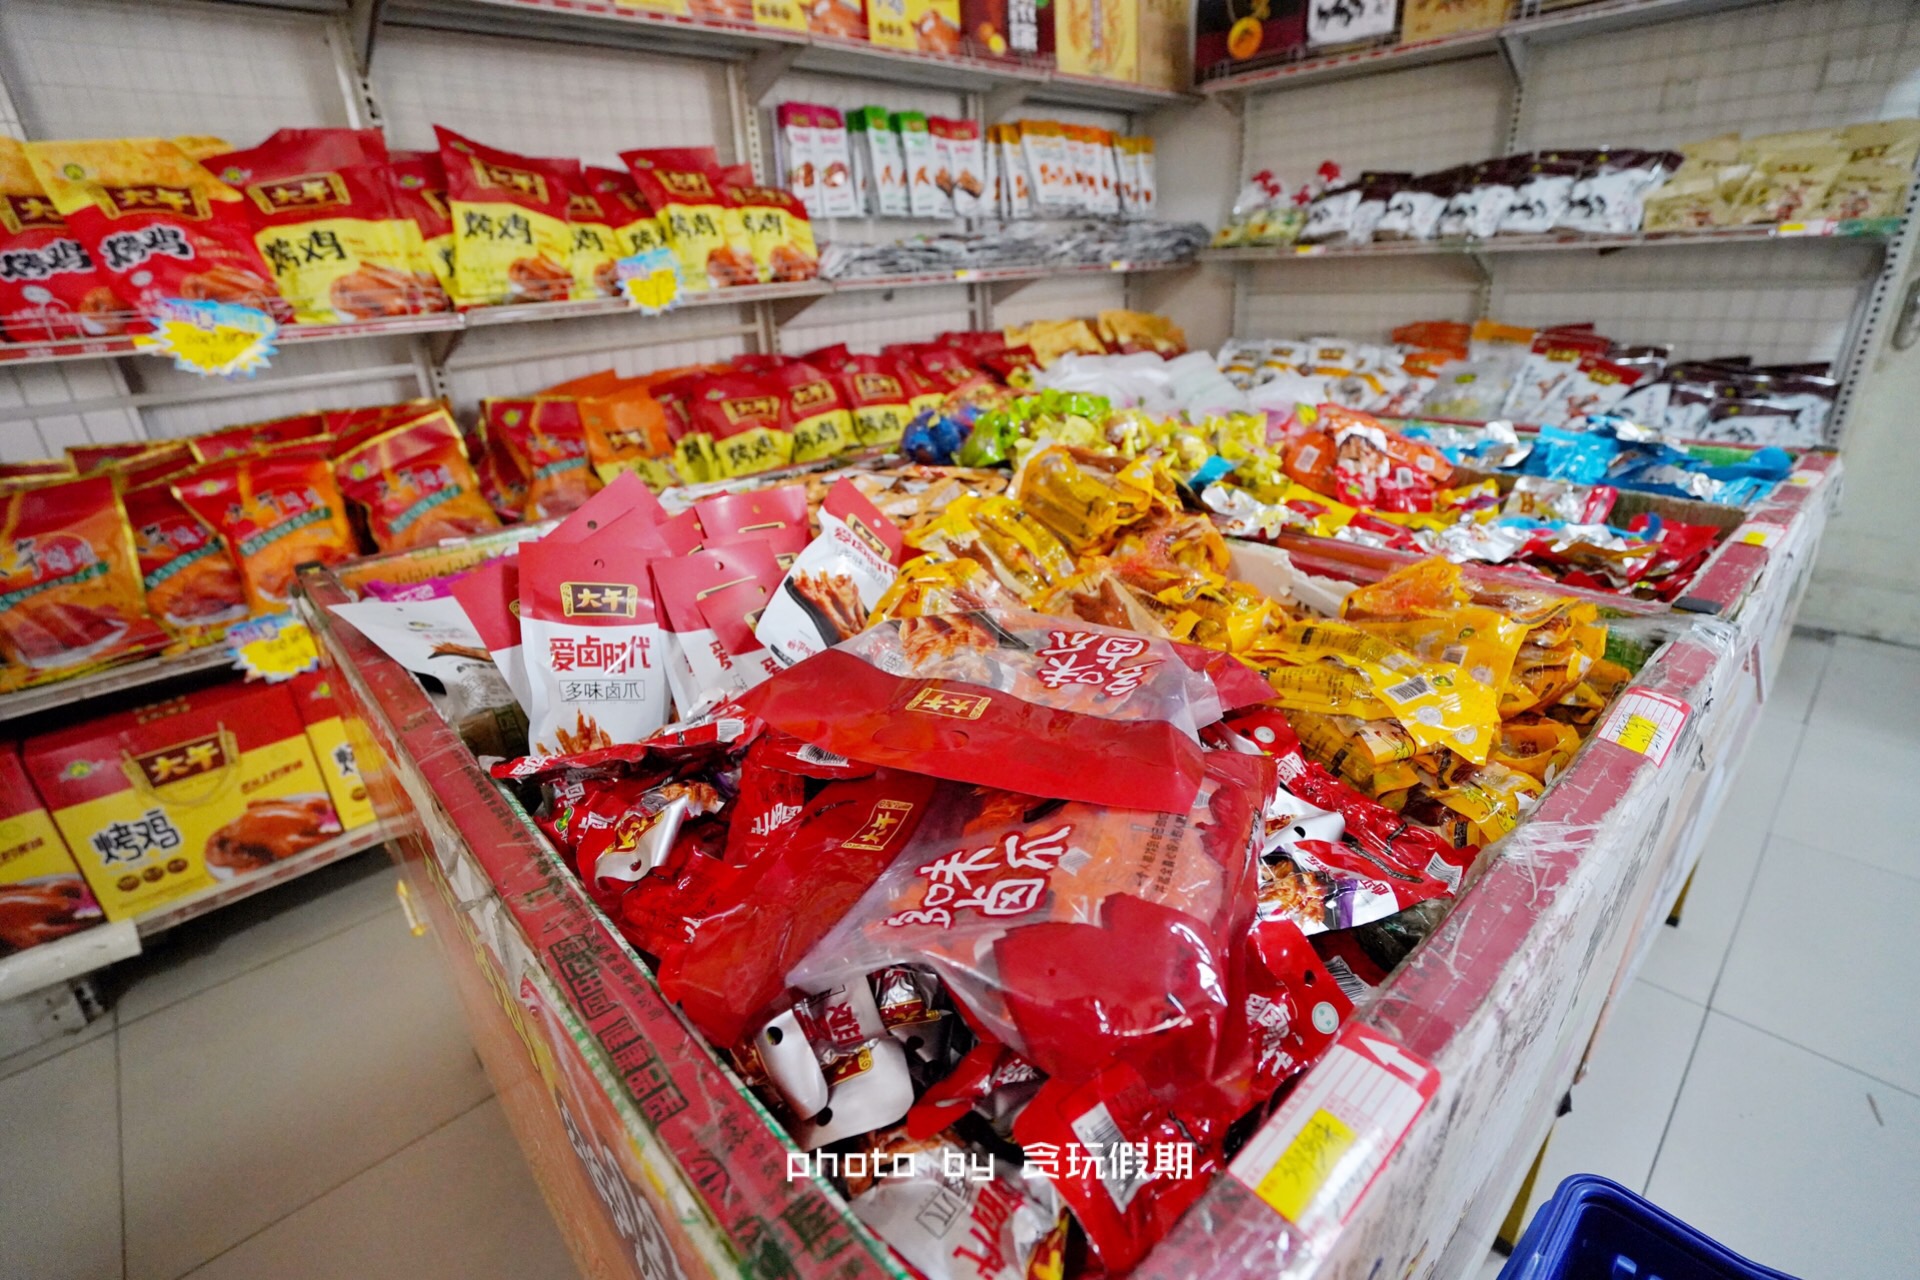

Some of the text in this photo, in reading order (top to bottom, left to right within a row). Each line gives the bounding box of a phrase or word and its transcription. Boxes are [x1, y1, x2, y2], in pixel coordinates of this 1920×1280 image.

[576, 588, 626, 612] 大午
[549, 635, 651, 674] 爱卤时代
[565, 681, 642, 701] 多味卤爪
[150, 741, 220, 783] 大午
[92, 808, 181, 865] 烤鸡
[860, 811, 900, 846] 大午
